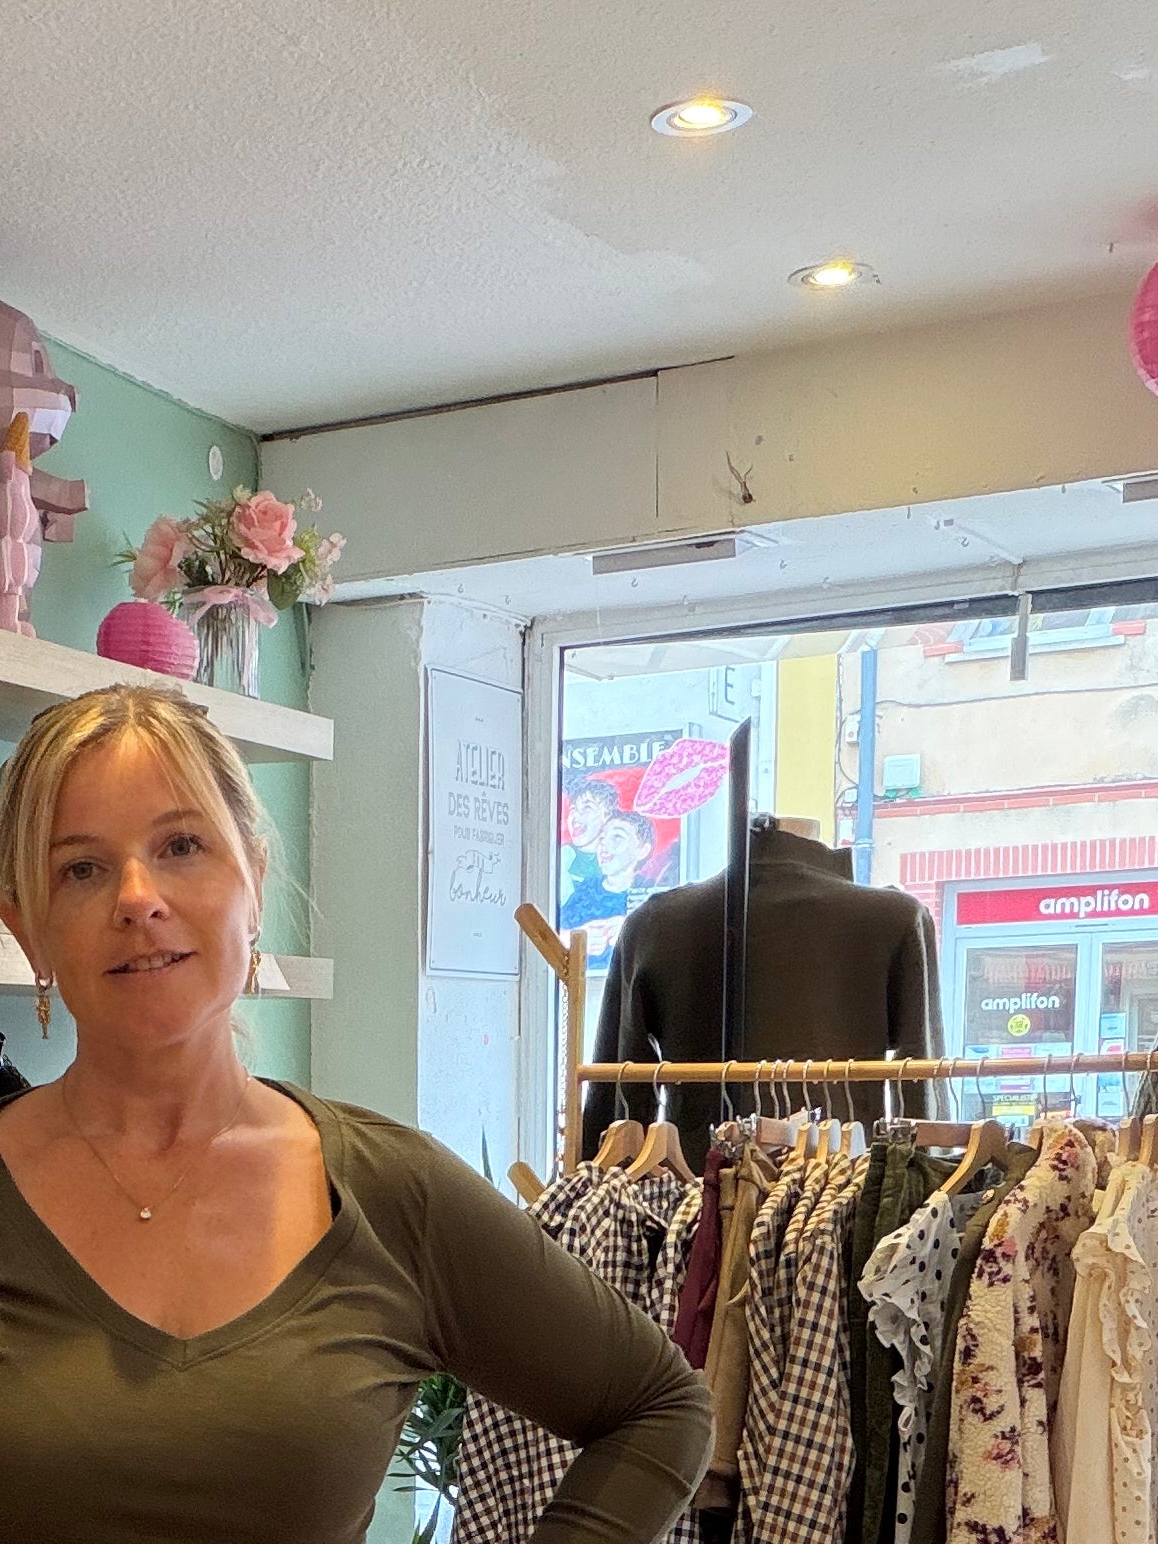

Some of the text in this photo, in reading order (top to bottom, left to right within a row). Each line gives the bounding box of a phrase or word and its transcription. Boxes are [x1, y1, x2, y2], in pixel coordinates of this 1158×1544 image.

[454, 740, 506, 791] ATELIER
[447, 791, 510, 826] DES RÊVES
[453, 825, 471, 841] POUR
[449, 867, 507, 906] bonheur
[1039, 889, 1150, 918] amplifon
[980, 992, 1061, 1015] amplifon
